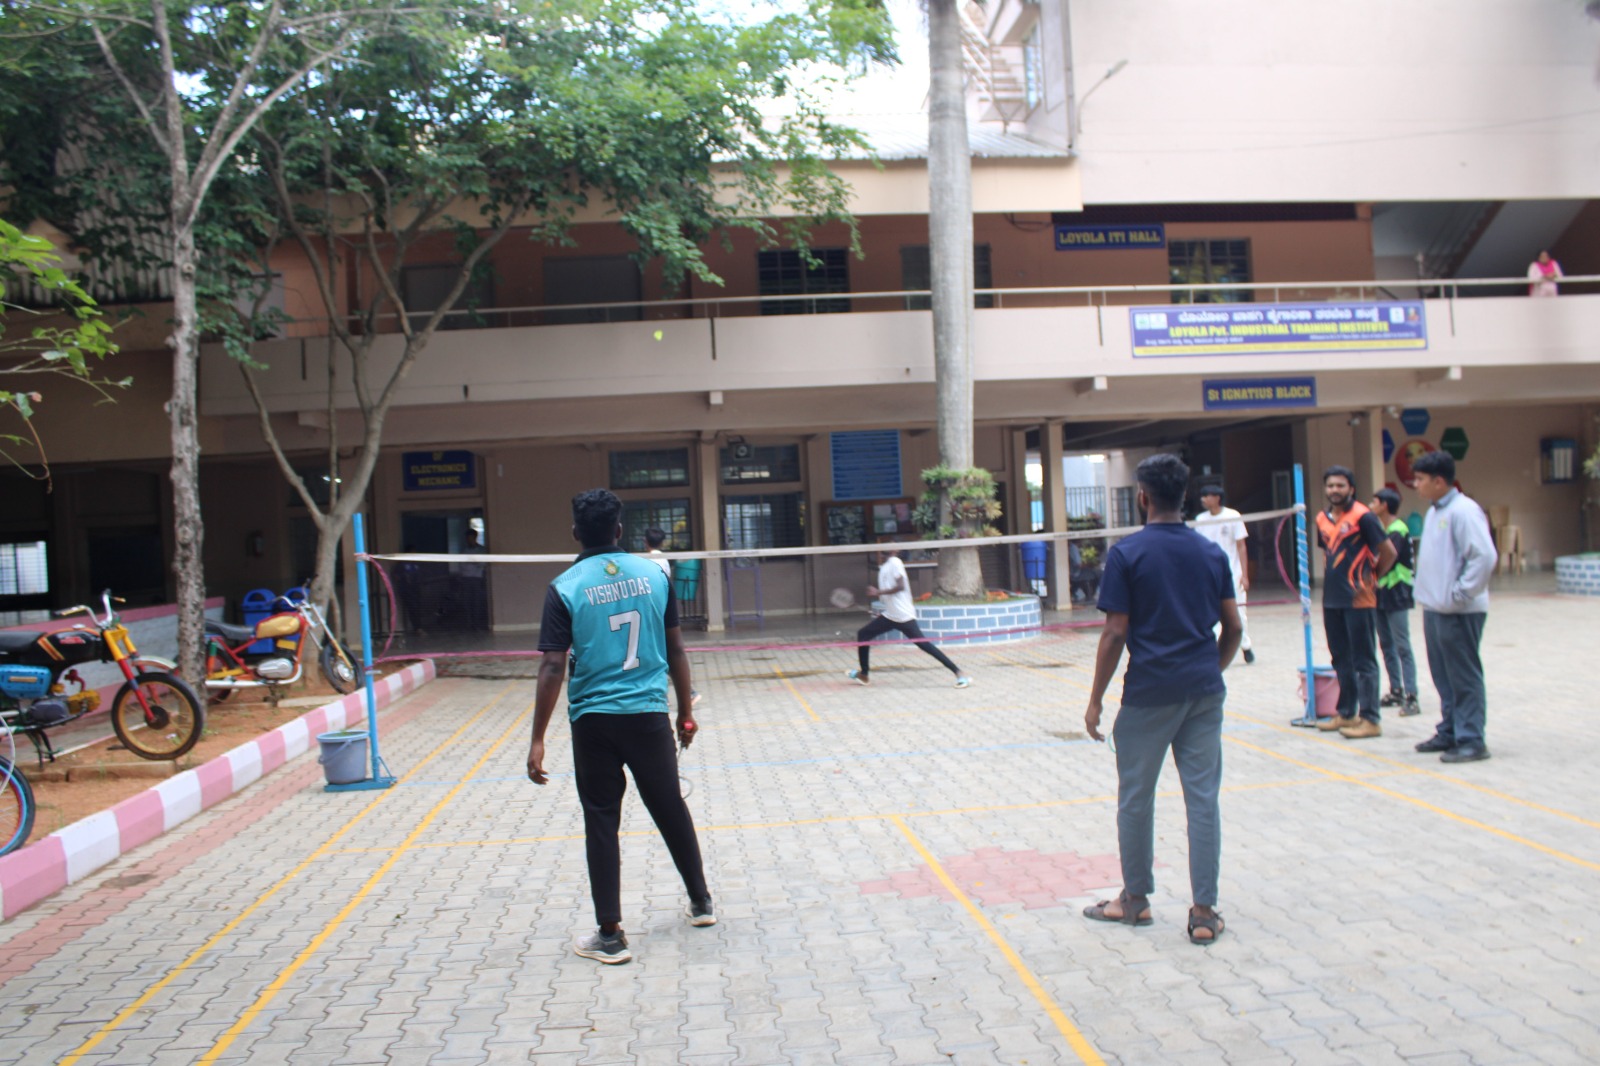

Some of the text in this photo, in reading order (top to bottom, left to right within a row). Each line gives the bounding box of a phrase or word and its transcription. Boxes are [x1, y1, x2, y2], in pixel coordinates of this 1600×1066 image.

[1059, 229, 1161, 244] LOYOLA ITI HALL
[1169, 326, 1208, 338] LOYOLA
[1229, 323, 1290, 337] INDUSTRIAL
[1290, 322, 1338, 334] TRAINING
[1339, 321, 1389, 333] INSTITUTE
[1208, 385, 1312, 401] St IGNATIUS BLOCK
[410, 463, 467, 474] ELECTRONICS
[417, 476, 461, 486] MECHANIC
[608, 609, 641, 671] 7
